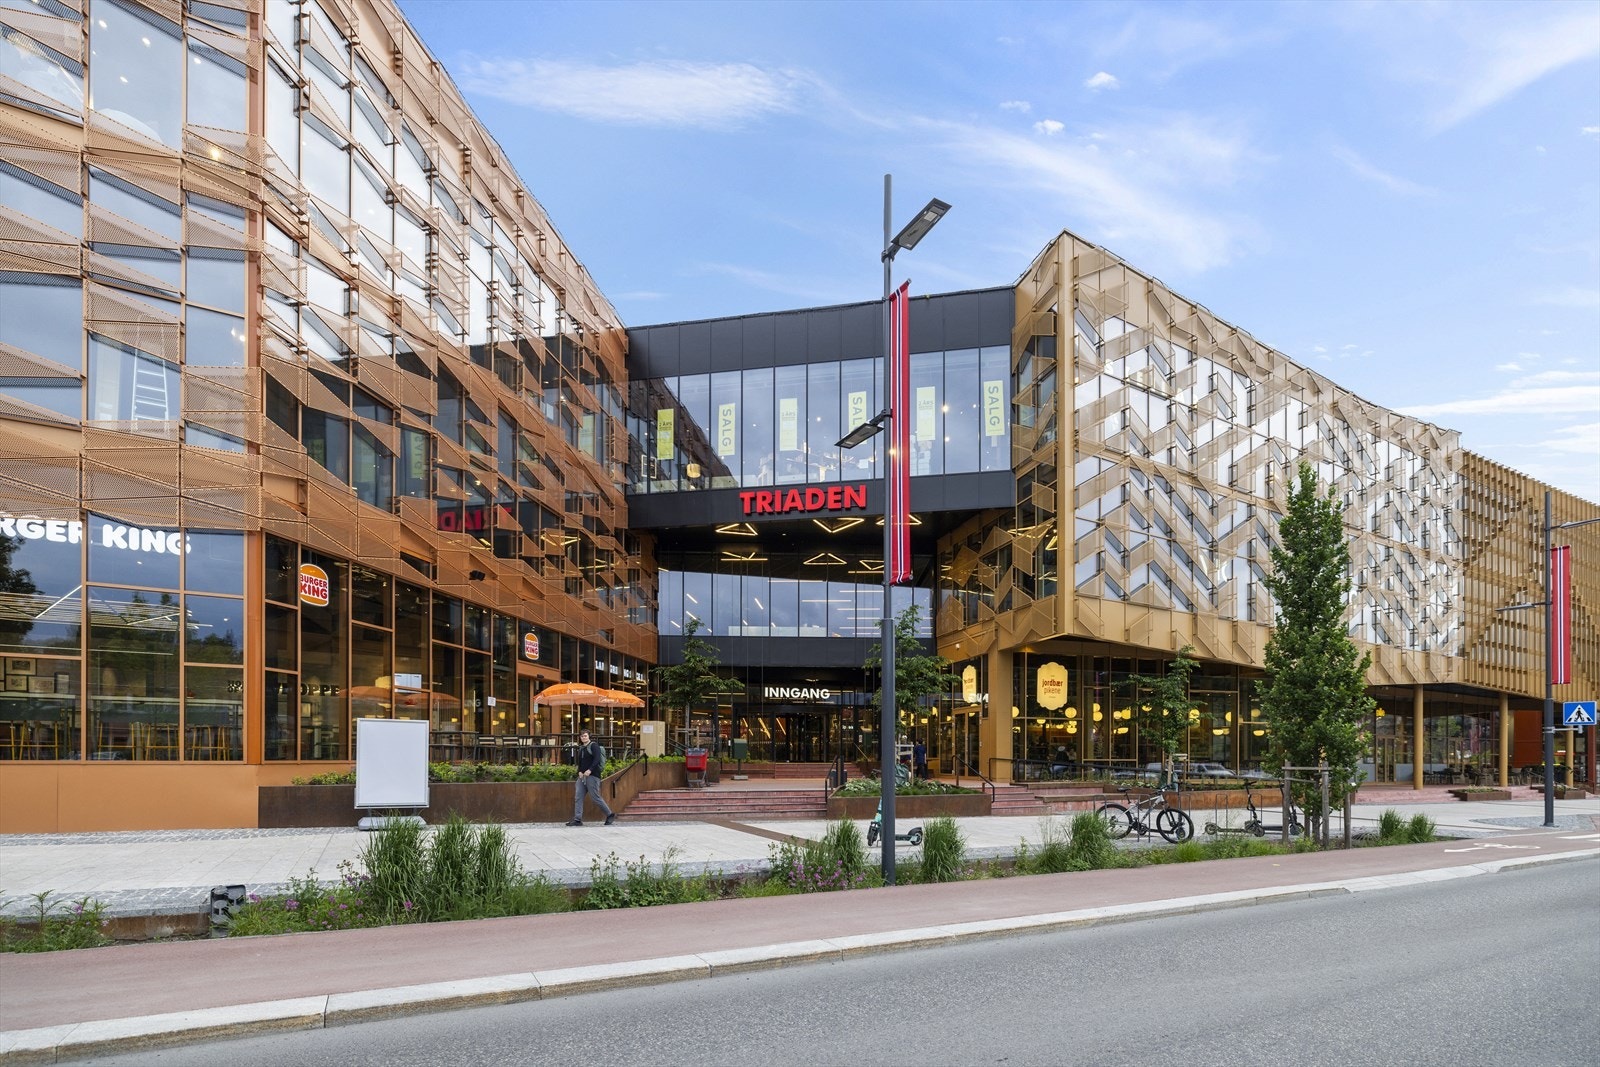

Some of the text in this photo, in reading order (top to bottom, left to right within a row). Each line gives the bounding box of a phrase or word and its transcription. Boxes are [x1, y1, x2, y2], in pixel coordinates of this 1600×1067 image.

[852, 396, 863, 425] SAL
[988, 385, 1001, 426] SALG
[722, 408, 732, 447] SALG
[739, 485, 866, 515] TRIADEN
[102, 524, 191, 555] KING
[300, 574, 327, 588] BURGER
[300, 583, 328, 599] KING
[526, 645, 538, 655] KING
[764, 687, 830, 699] INNGANG
[1042, 679, 1063, 687] jordbær
